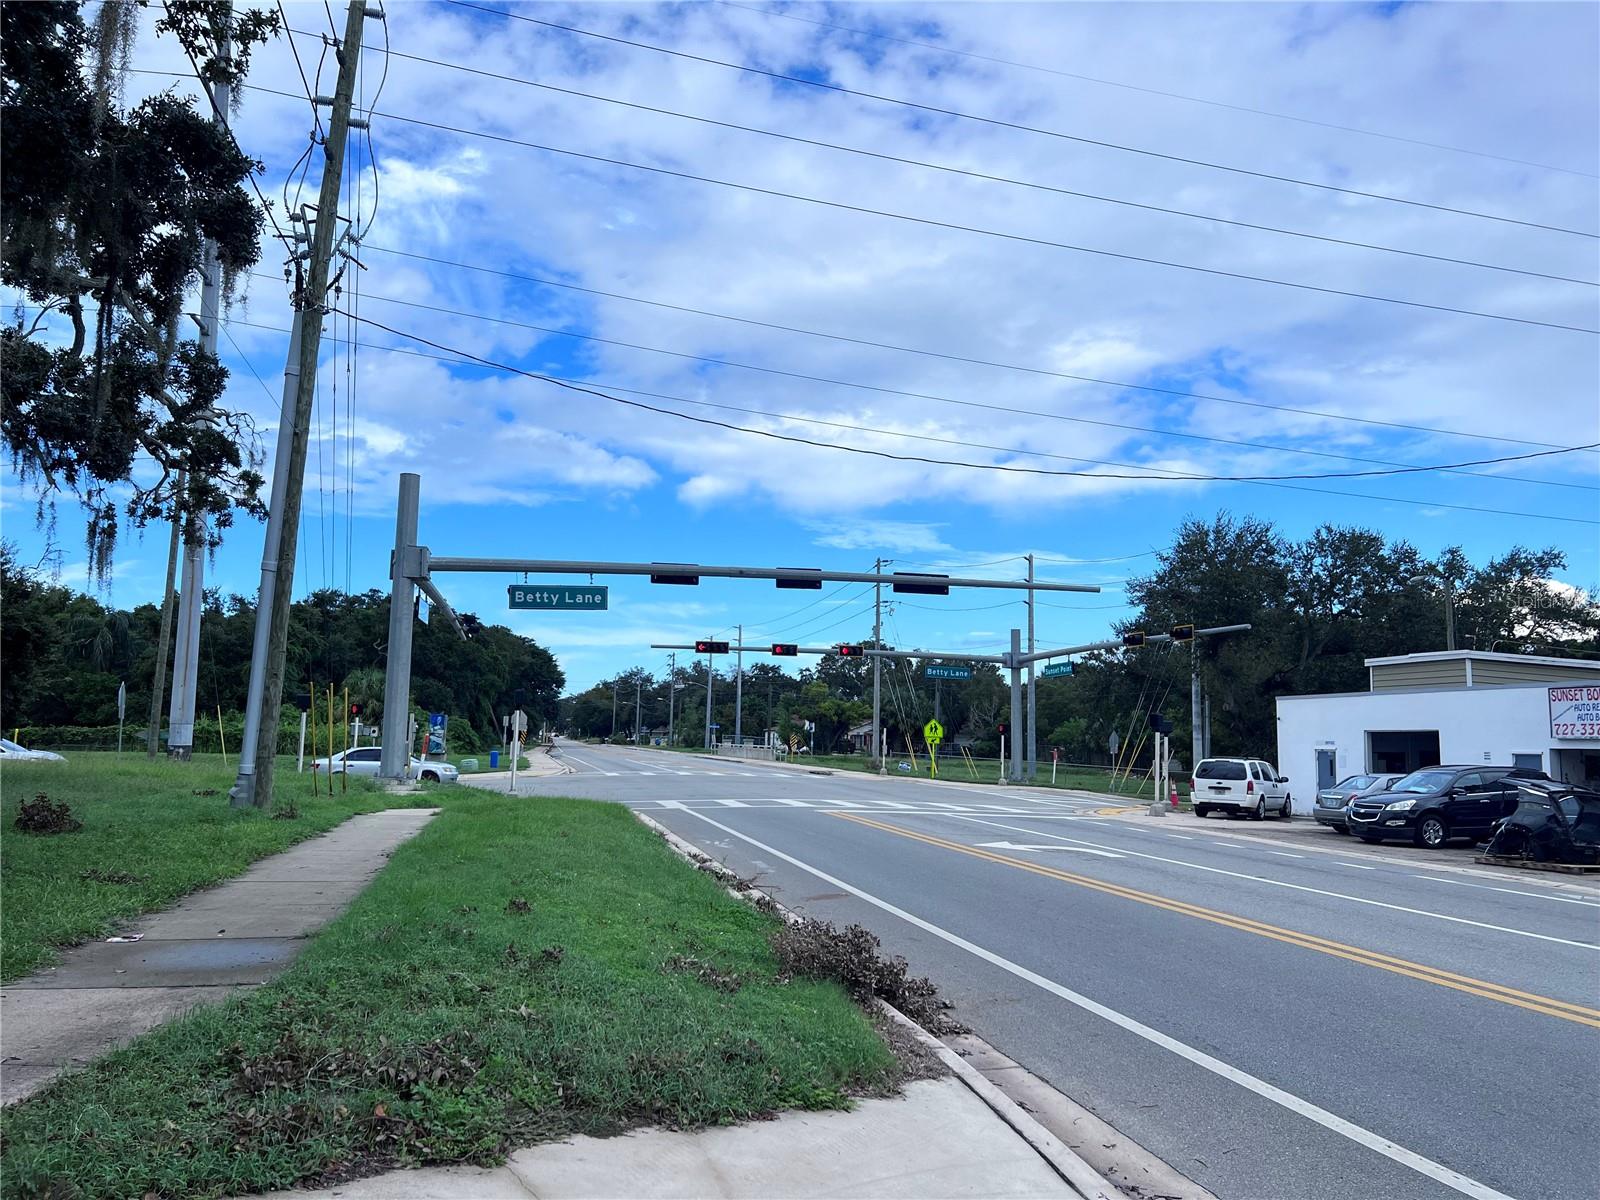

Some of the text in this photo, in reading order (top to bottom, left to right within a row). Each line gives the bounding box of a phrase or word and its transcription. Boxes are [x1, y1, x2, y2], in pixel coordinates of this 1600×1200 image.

[515, 591, 602, 605] Betty Lane
[927, 668, 949, 677] Betty
[1551, 688, 1600, 702] SUNSET BO
[1574, 703, 1591, 712] AUTO
[1577, 713, 1600, 721] AUTO B
